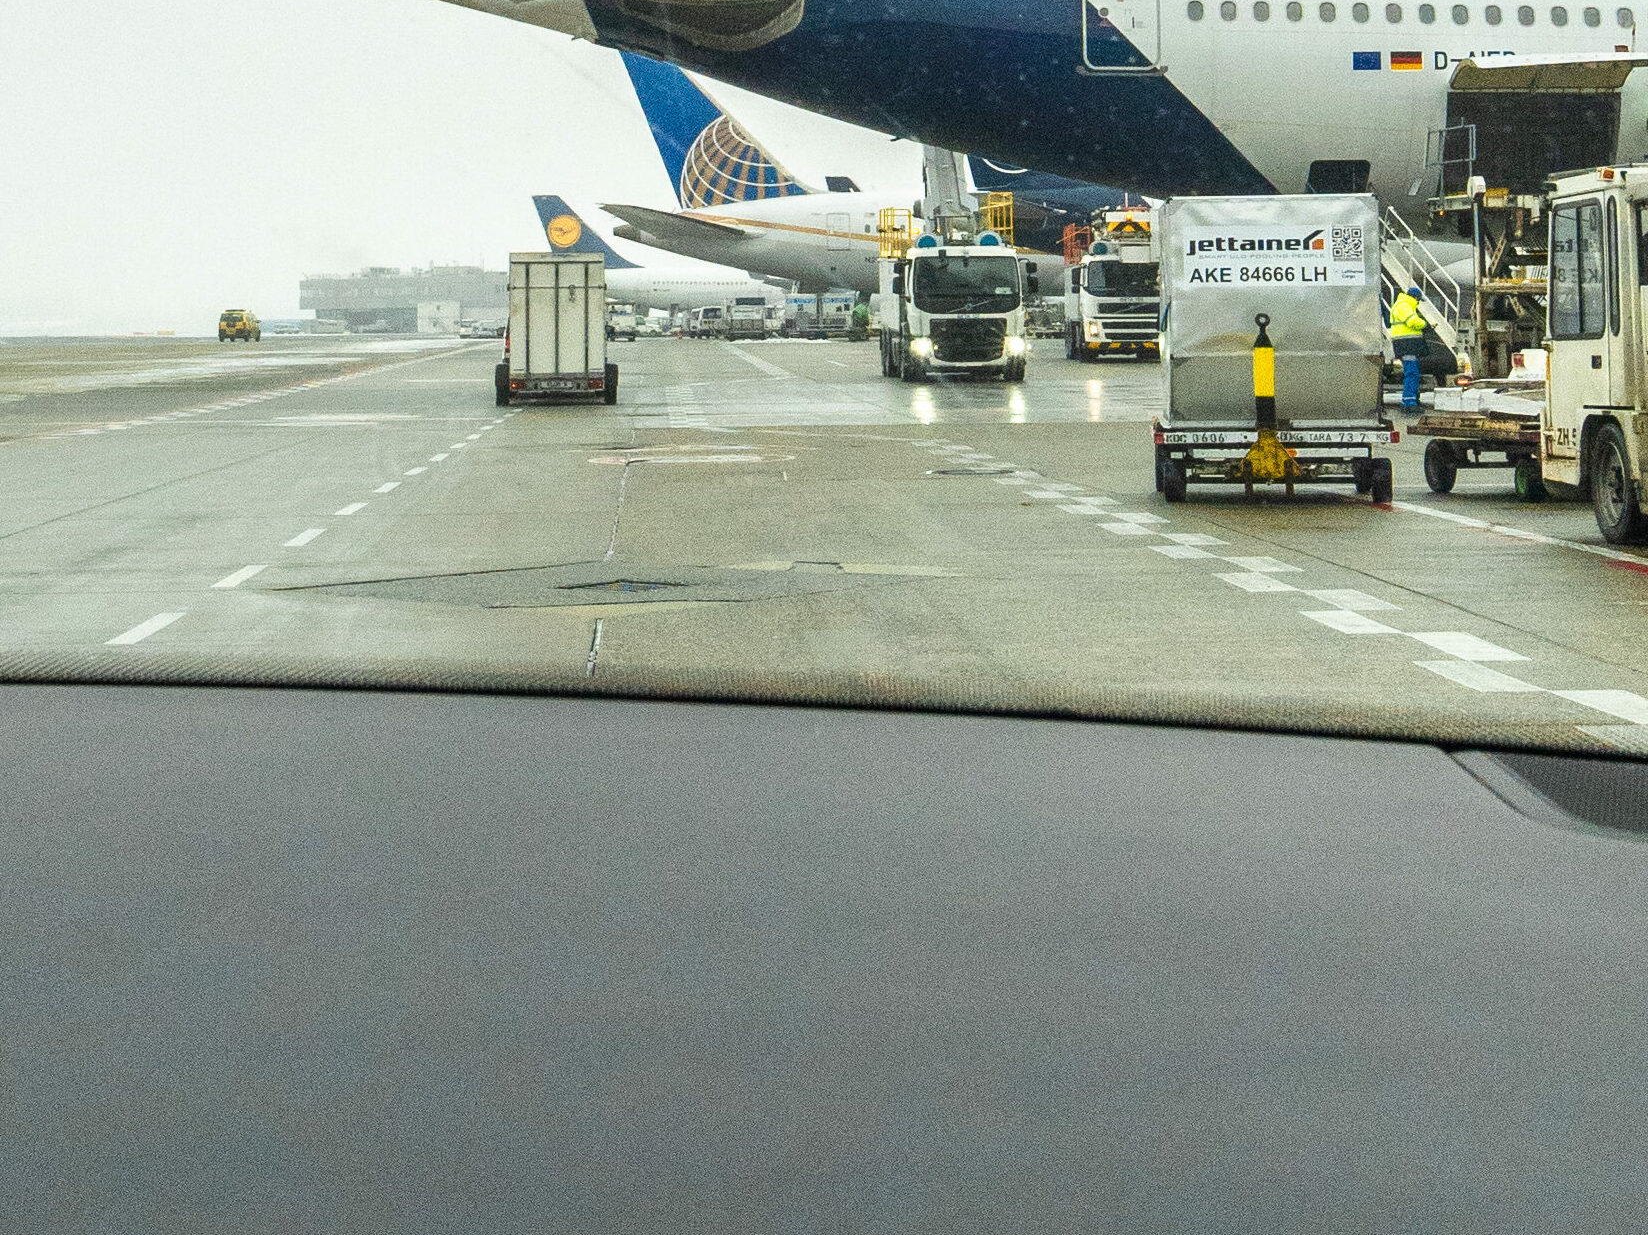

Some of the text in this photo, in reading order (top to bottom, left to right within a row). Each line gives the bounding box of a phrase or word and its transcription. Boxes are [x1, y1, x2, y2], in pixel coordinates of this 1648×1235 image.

[1186, 229, 1325, 256] jettainer
[1189, 266, 1328, 283] AKE 84666 LH
[1309, 433, 1332, 441] TARA
[1376, 433, 1389, 441] KG
[1557, 427, 1570, 446] ZH
